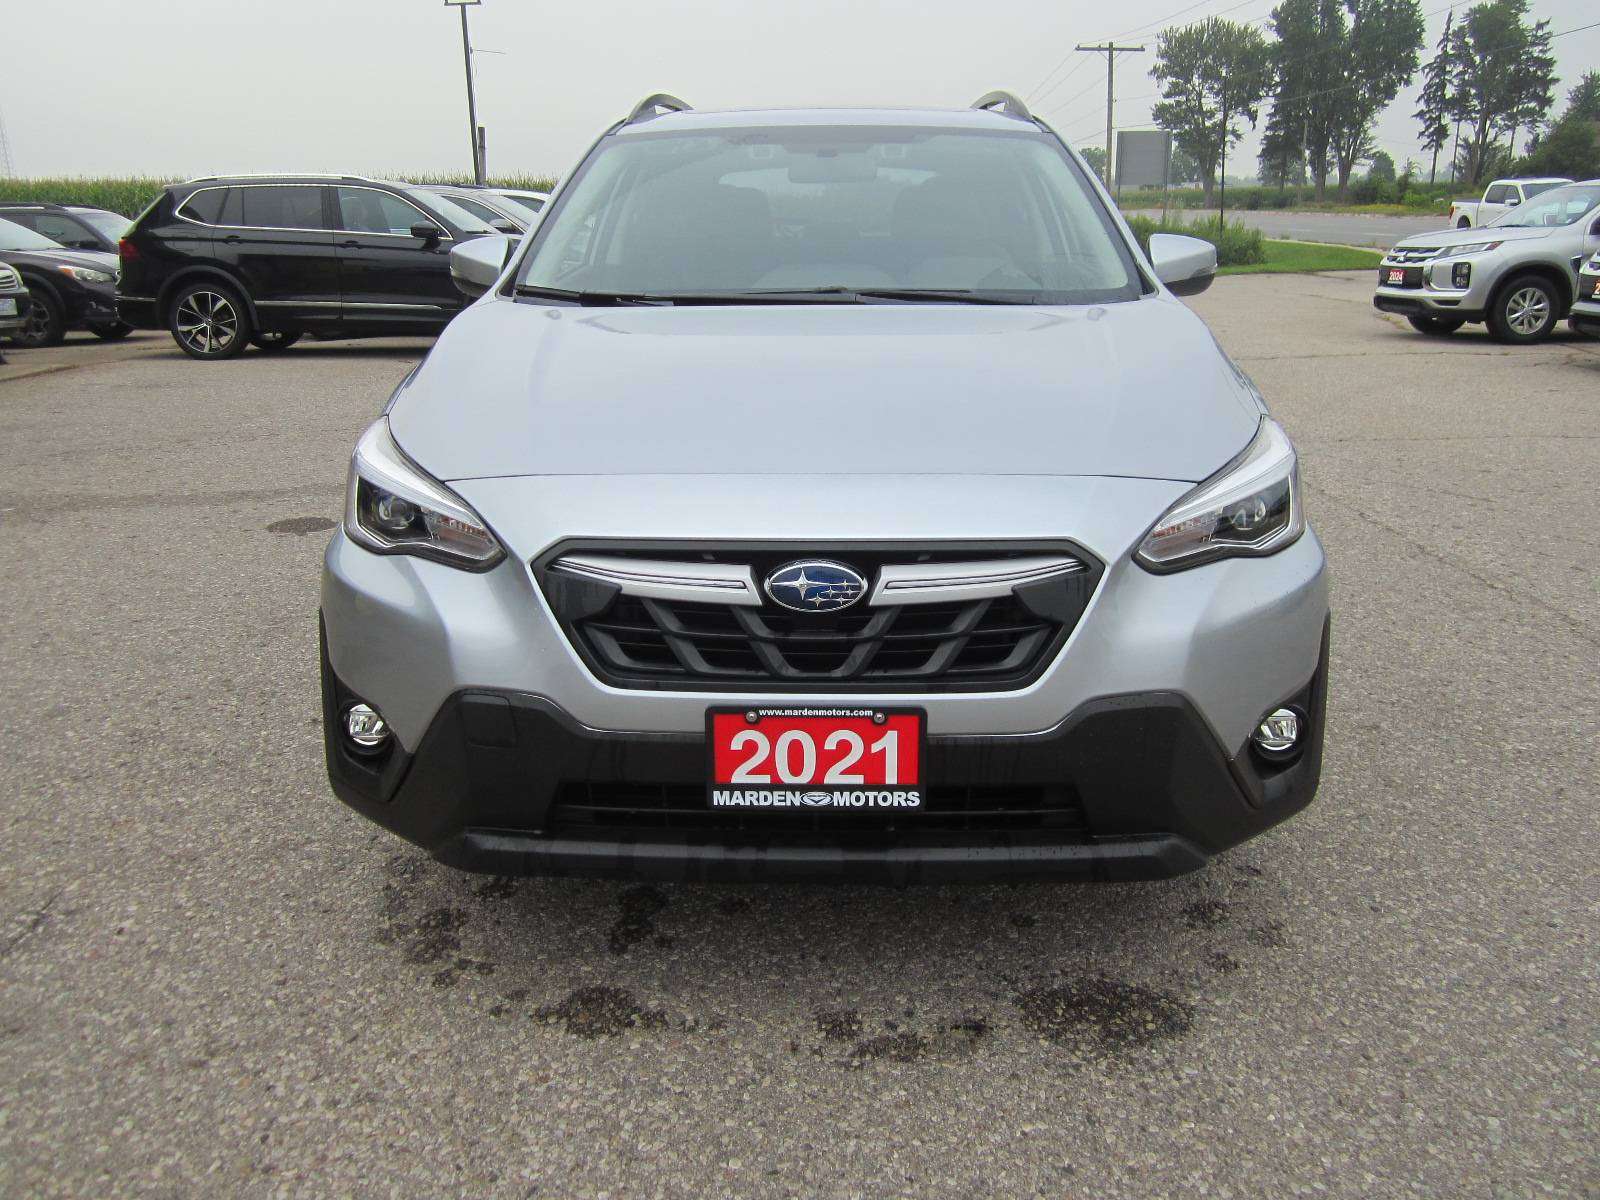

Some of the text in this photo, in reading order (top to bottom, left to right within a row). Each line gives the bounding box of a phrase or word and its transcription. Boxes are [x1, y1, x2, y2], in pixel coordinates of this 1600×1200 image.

[758, 707, 873, 717] www.mardenmotors.com
[730, 729, 898, 784] 2021
[713, 790, 921, 807] MARDEN MOTORS
